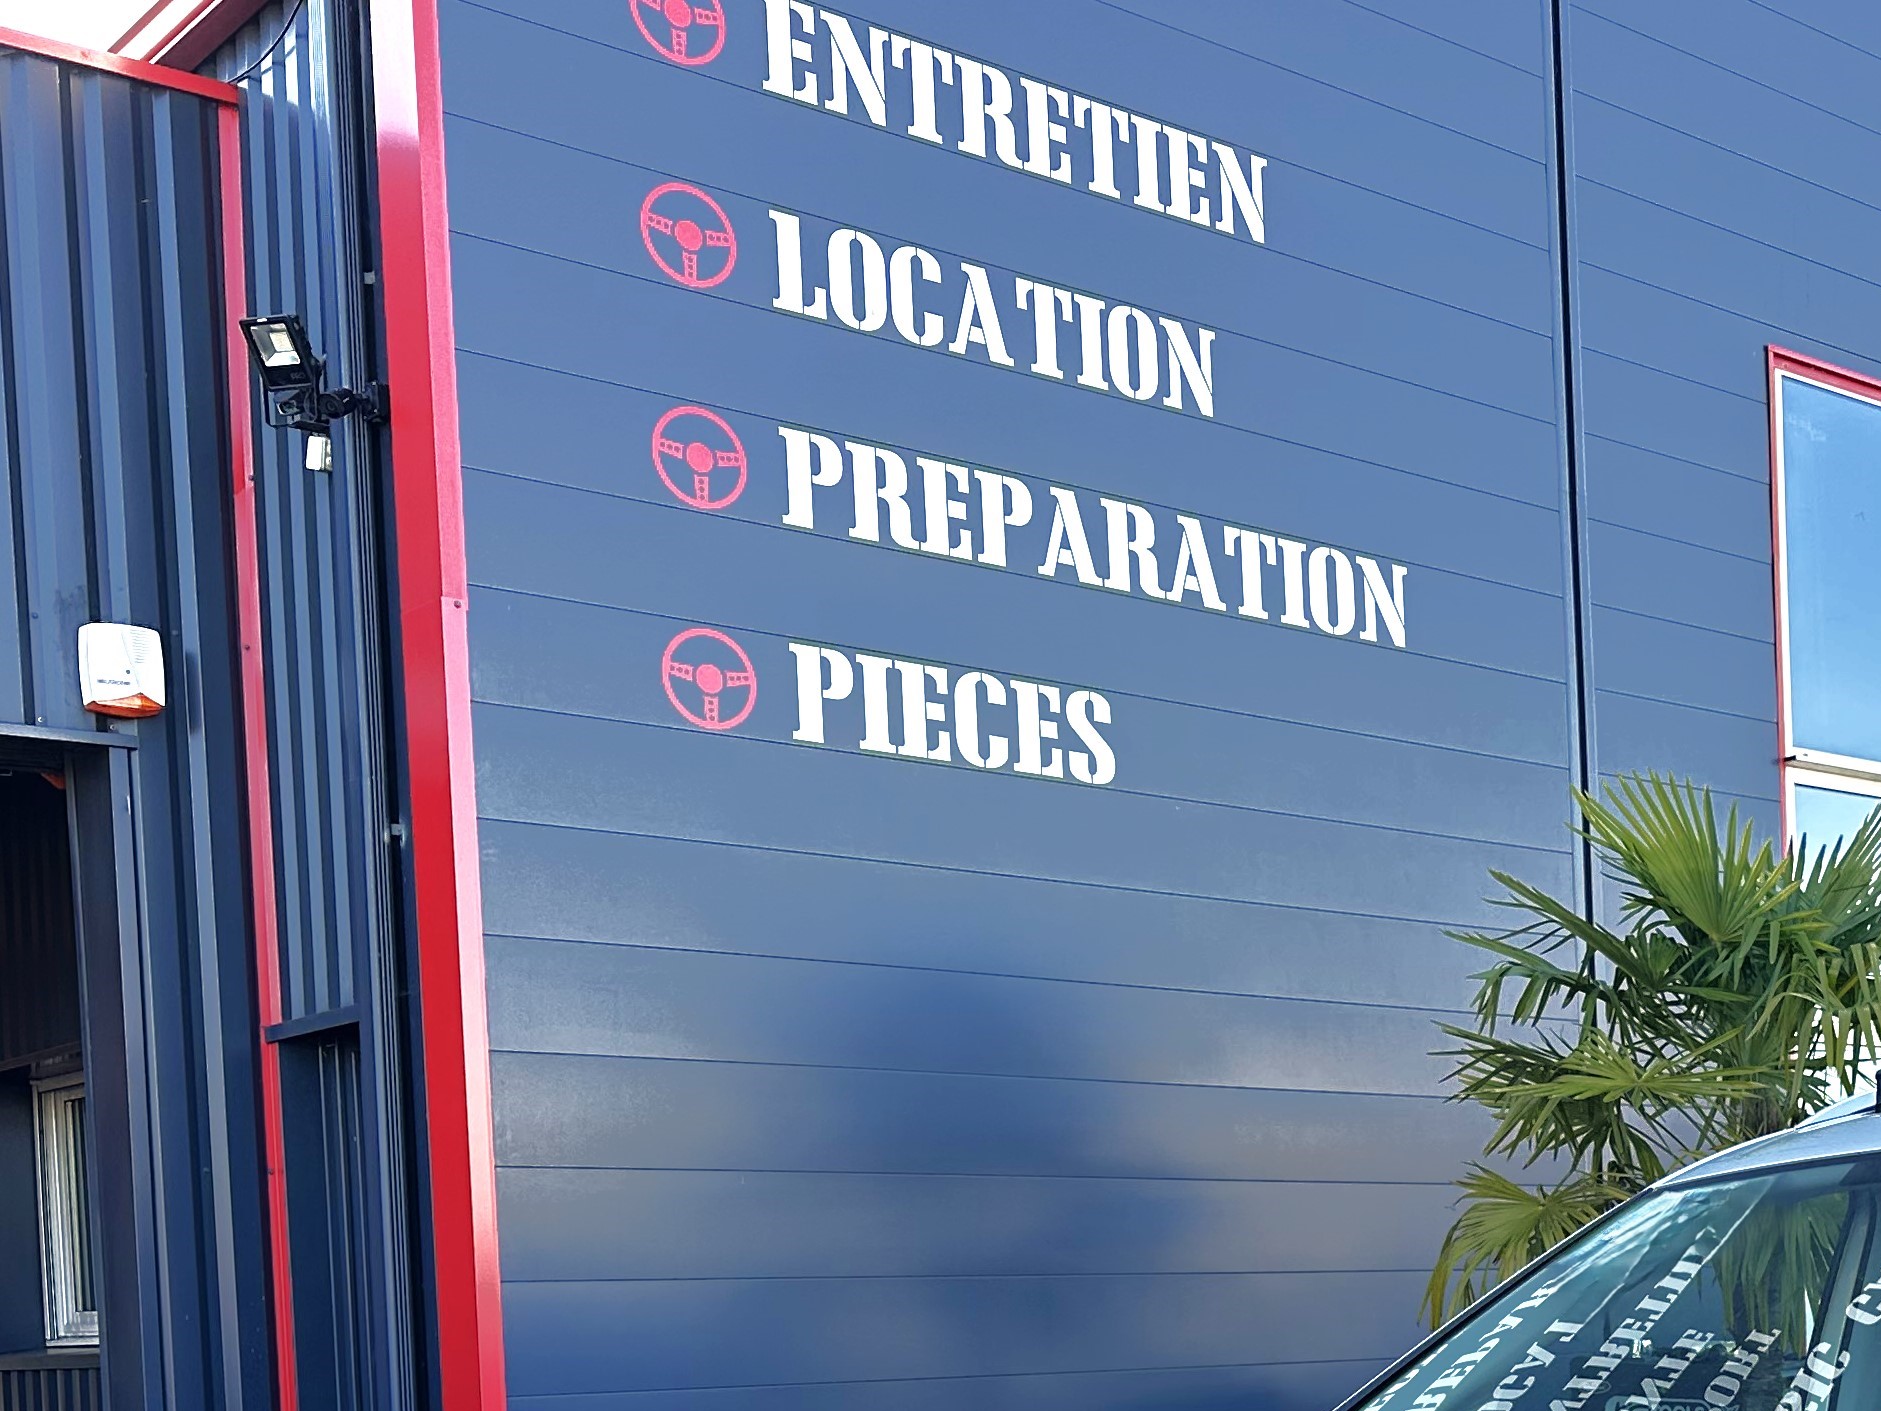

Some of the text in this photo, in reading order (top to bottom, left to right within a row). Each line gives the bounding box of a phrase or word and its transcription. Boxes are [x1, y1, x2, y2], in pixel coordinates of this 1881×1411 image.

[763, 0, 1268, 244] ENTRETIEN
[768, 209, 1216, 417] LOCATION
[778, 426, 1408, 648] PREPARATION
[789, 642, 1117, 786] PIECES
